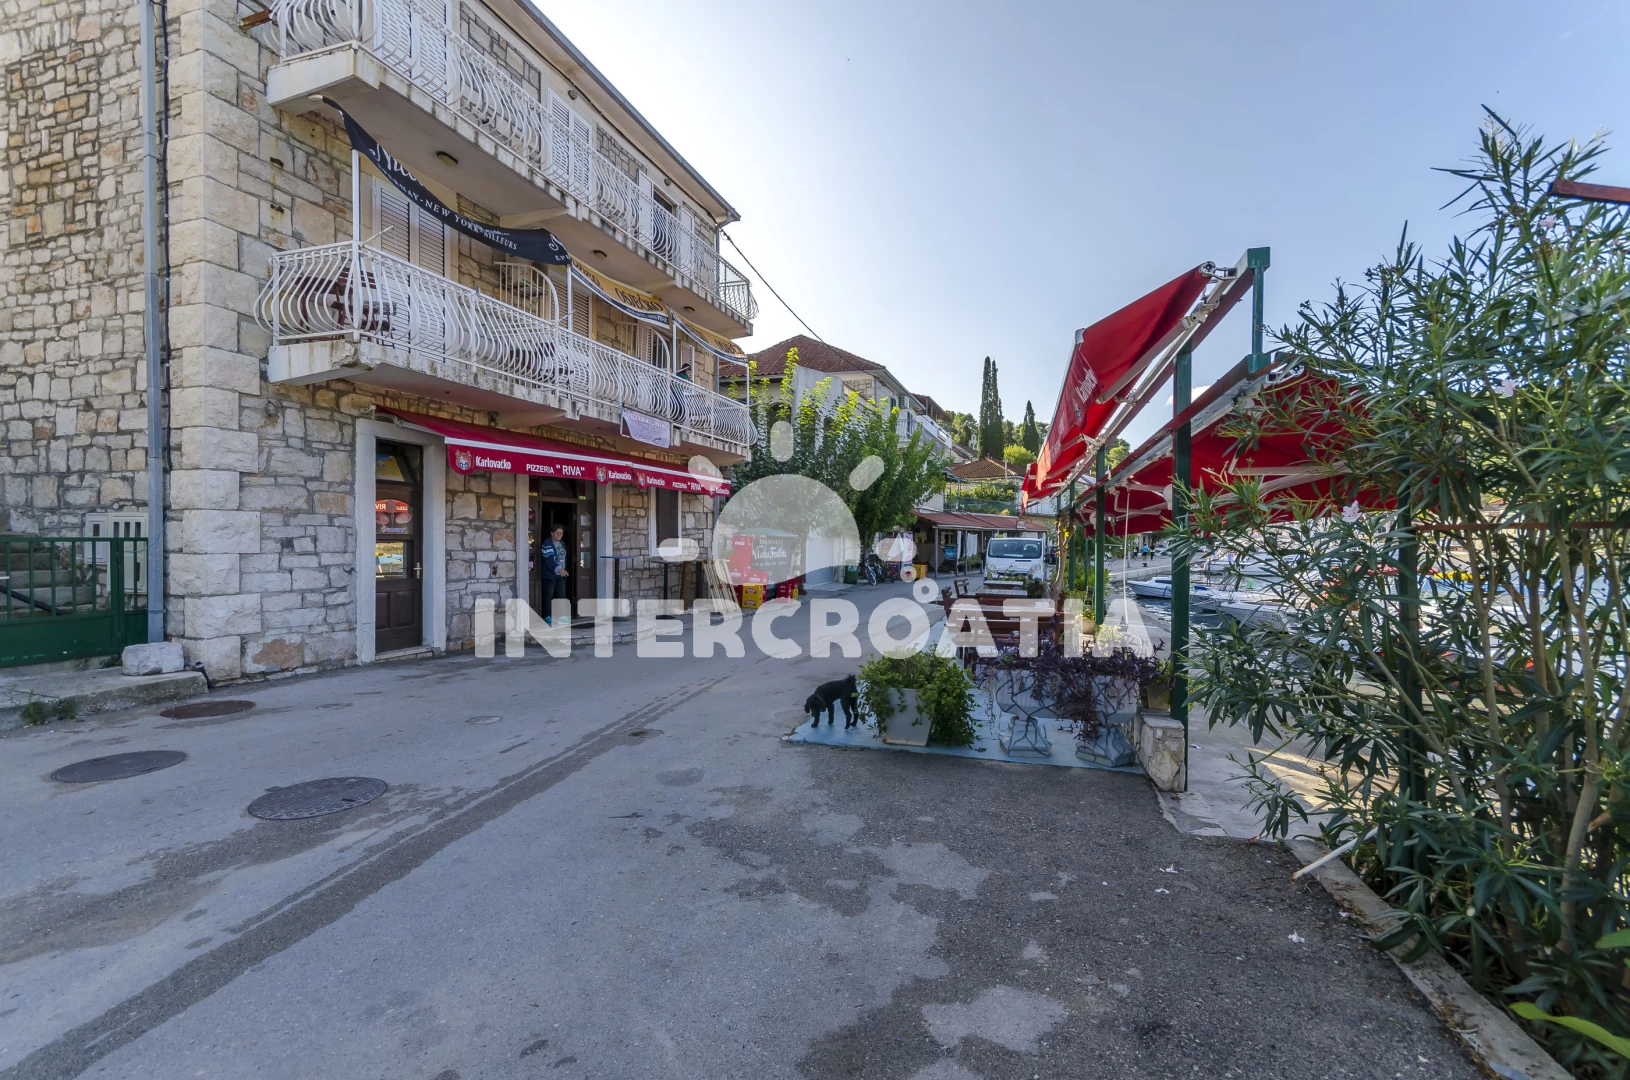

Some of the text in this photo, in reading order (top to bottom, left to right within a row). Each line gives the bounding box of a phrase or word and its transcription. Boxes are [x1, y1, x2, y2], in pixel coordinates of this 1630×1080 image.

[425, 200, 450, 217] NEW
[475, 455, 511, 470] Karlovačko
[526, 463, 554, 474] PIZZERIA
